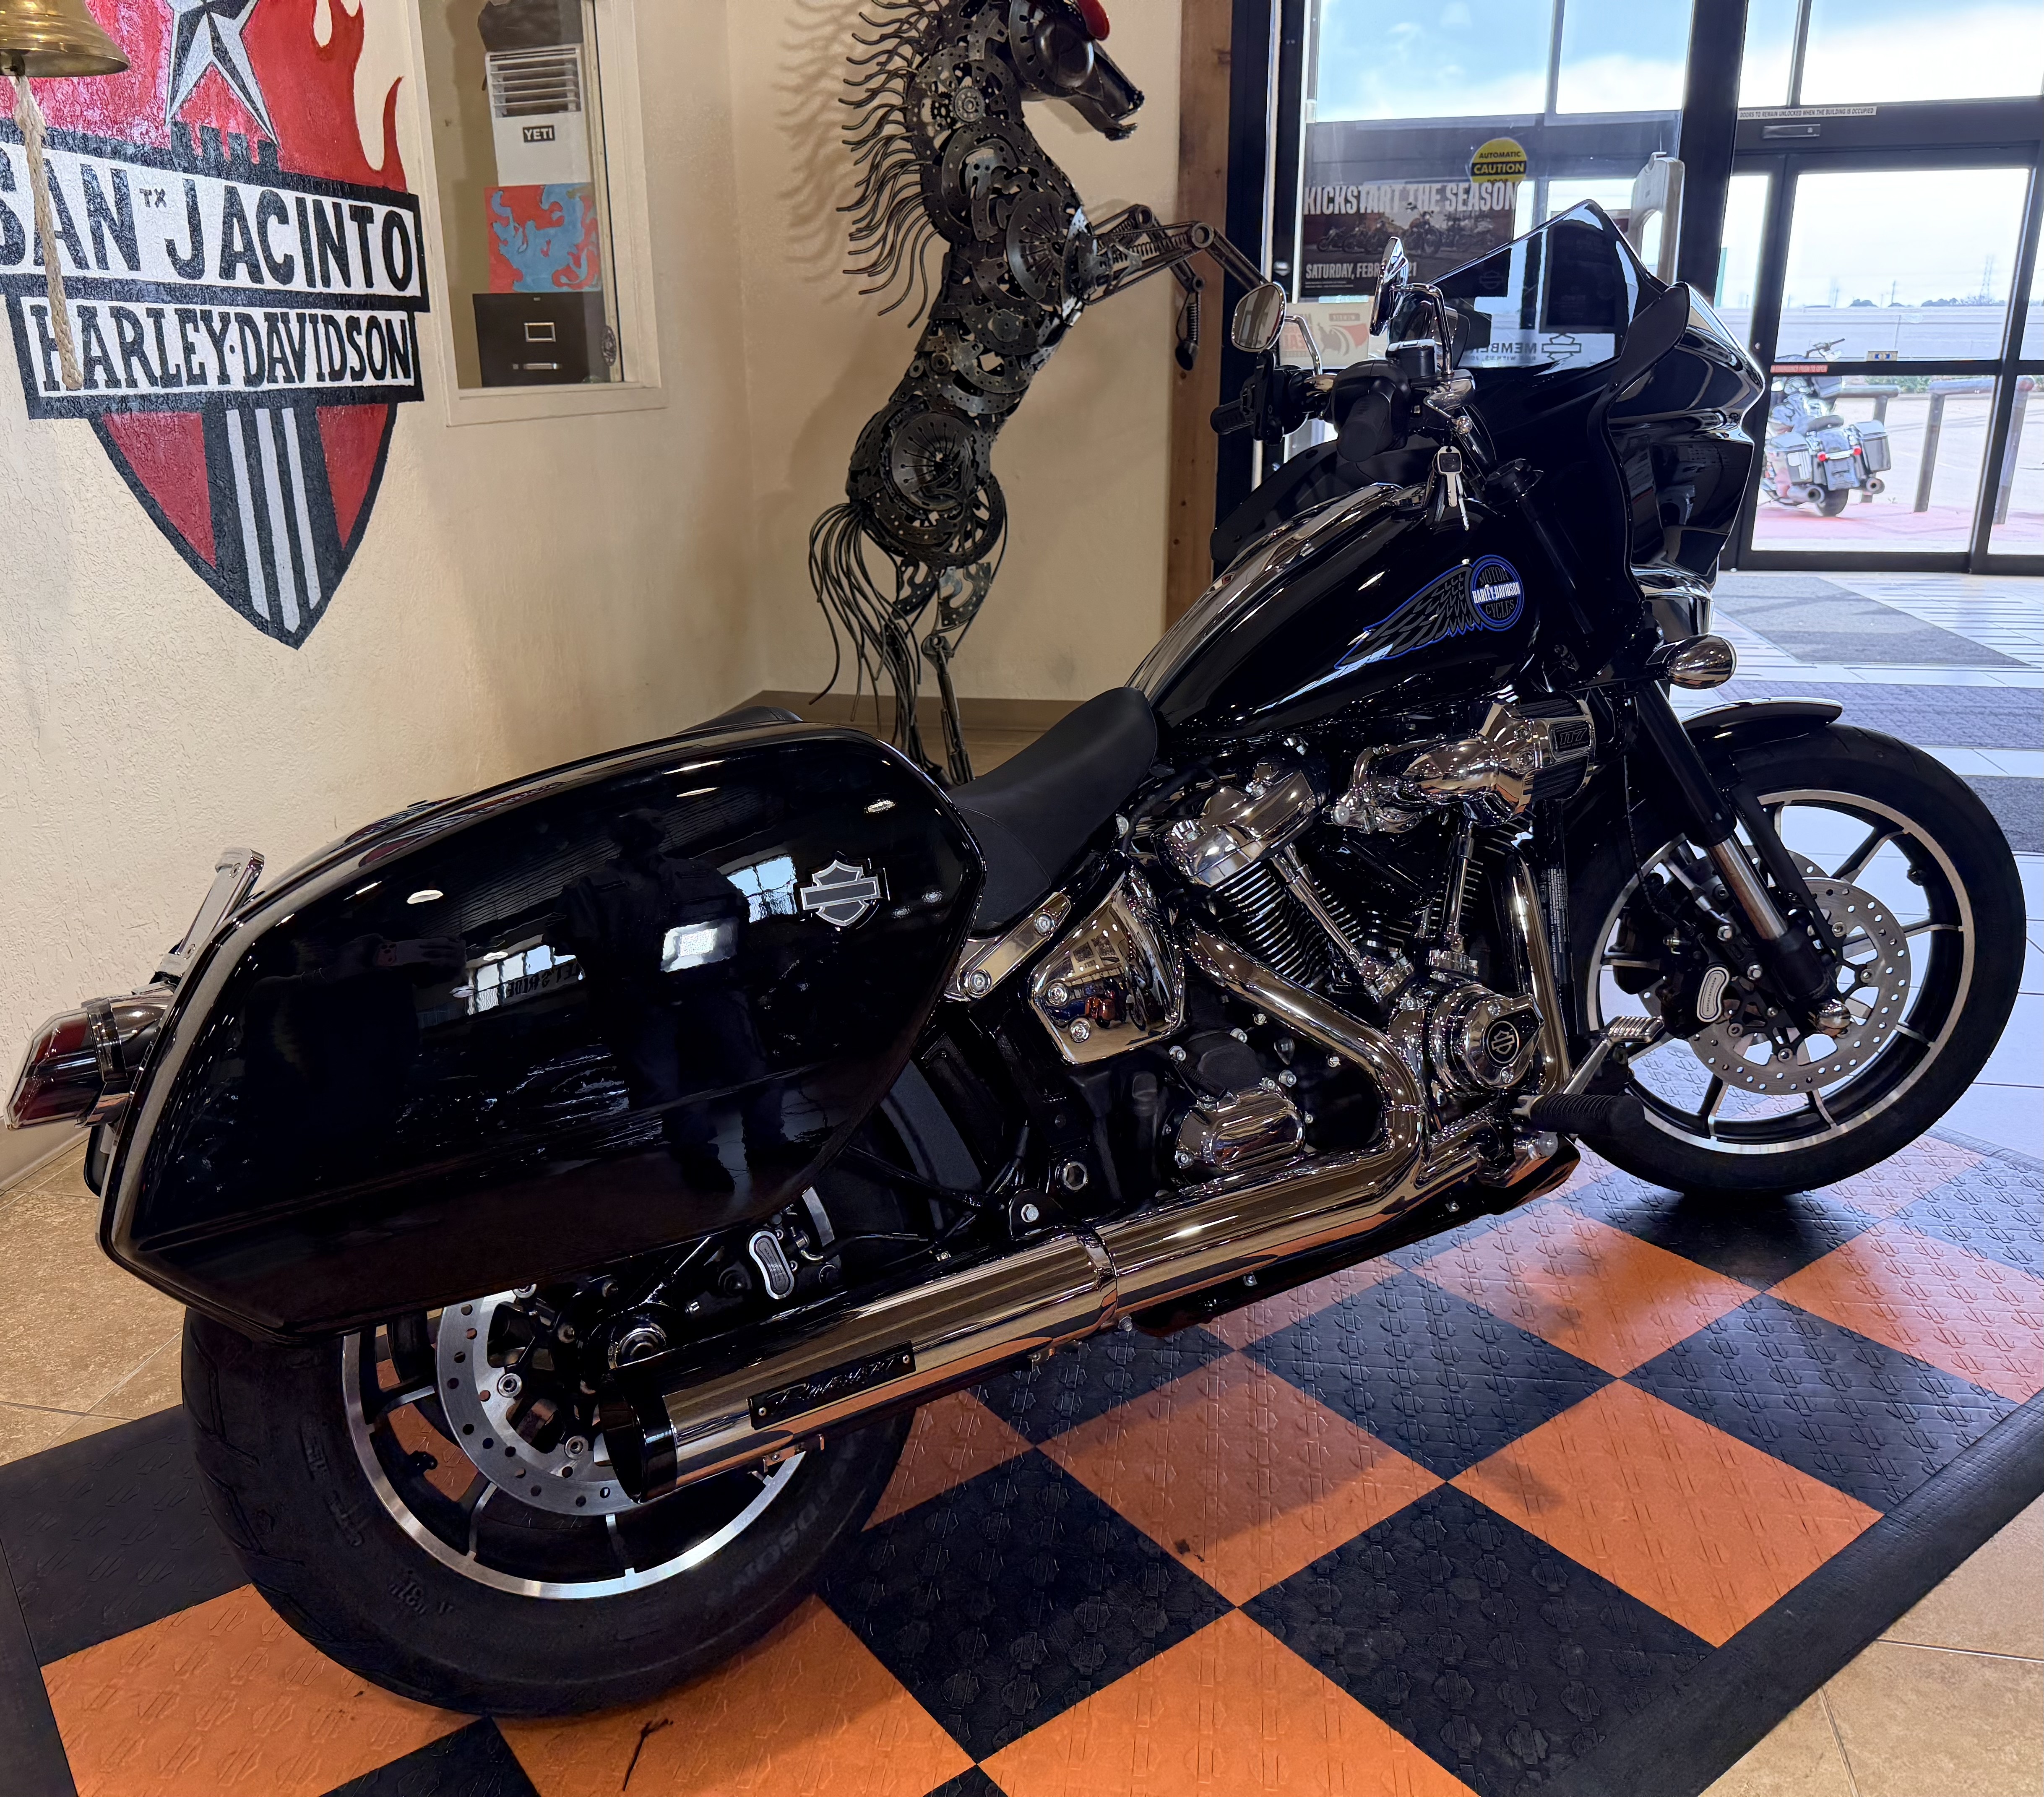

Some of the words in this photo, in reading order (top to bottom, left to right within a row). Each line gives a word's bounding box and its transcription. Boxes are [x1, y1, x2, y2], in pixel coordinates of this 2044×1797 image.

[523, 127, 553, 141] YETI
[1479, 151, 1522, 159] AUTOMATIC
[1474, 162, 1525, 175] CAUTION
[139, 188, 167, 208] TX
[1303, 184, 1401, 215] KICKSTART
[1407, 184, 1441, 212] THE
[1445, 181, 1517, 211] SEASON
[164, 178, 412, 292] JACINTO
[1305, 263, 1355, 280] SATURDAY,
[1356, 262, 1383, 278] FEBR
[1479, 567, 1509, 585] MOTOR
[1472, 582, 1521, 604] HARLEY-DAVIDSON
[1485, 599, 1514, 619] CYCLES
[1560, 727, 1587, 745] 117
